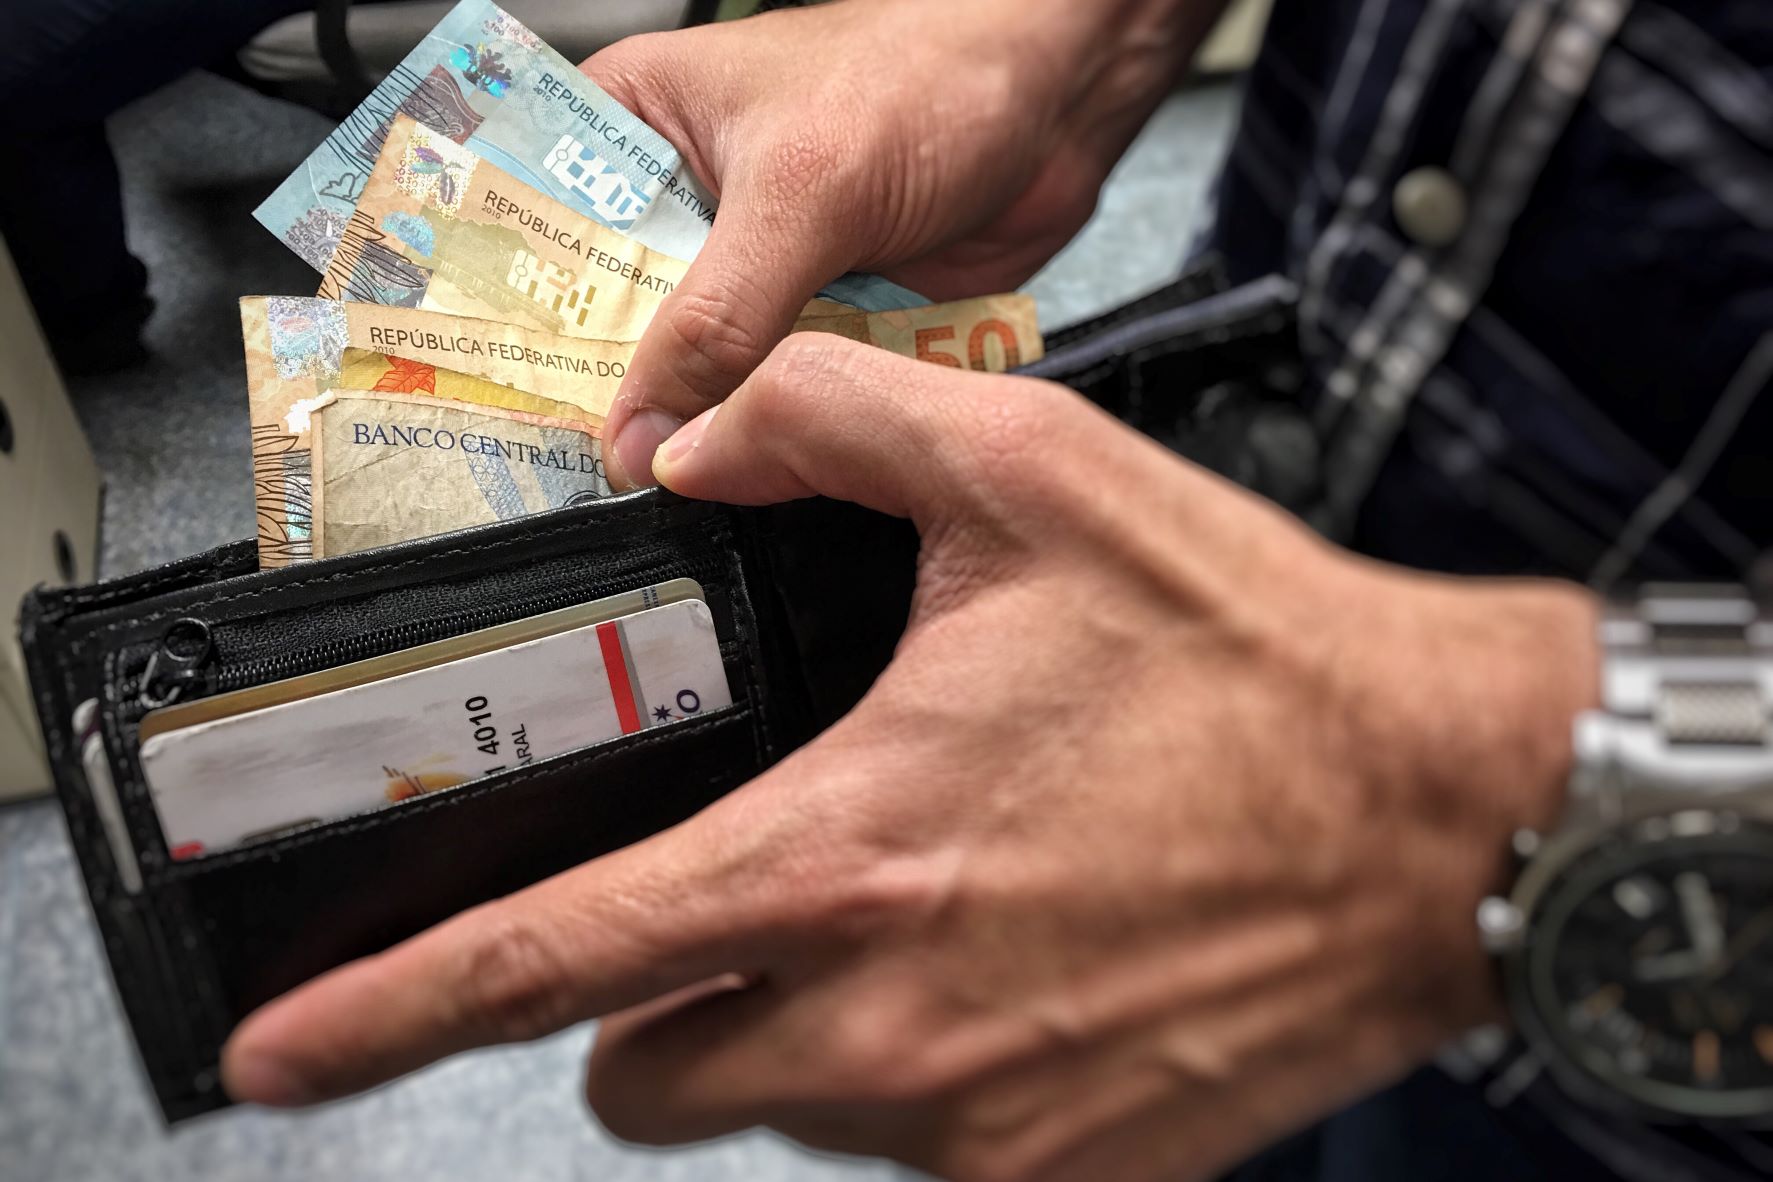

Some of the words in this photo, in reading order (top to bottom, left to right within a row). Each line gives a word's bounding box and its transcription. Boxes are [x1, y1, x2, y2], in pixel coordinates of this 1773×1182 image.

[533, 86, 552, 102] 2010
[538, 73, 627, 150] REPÚBLICA
[627, 146, 716, 227] FEDERATIVA
[481, 205, 501, 220] 2010
[484, 190, 582, 255] REPÚBLICA
[370, 327, 483, 356] REPÚBLICA
[488, 342, 592, 376] FEDERATIVA
[597, 361, 625, 378] DO
[915, 320, 1019, 372] 50
[353, 423, 455, 450] BANCO
[460, 433, 576, 474] CENTRAL
[465, 696, 500, 755] 4010
